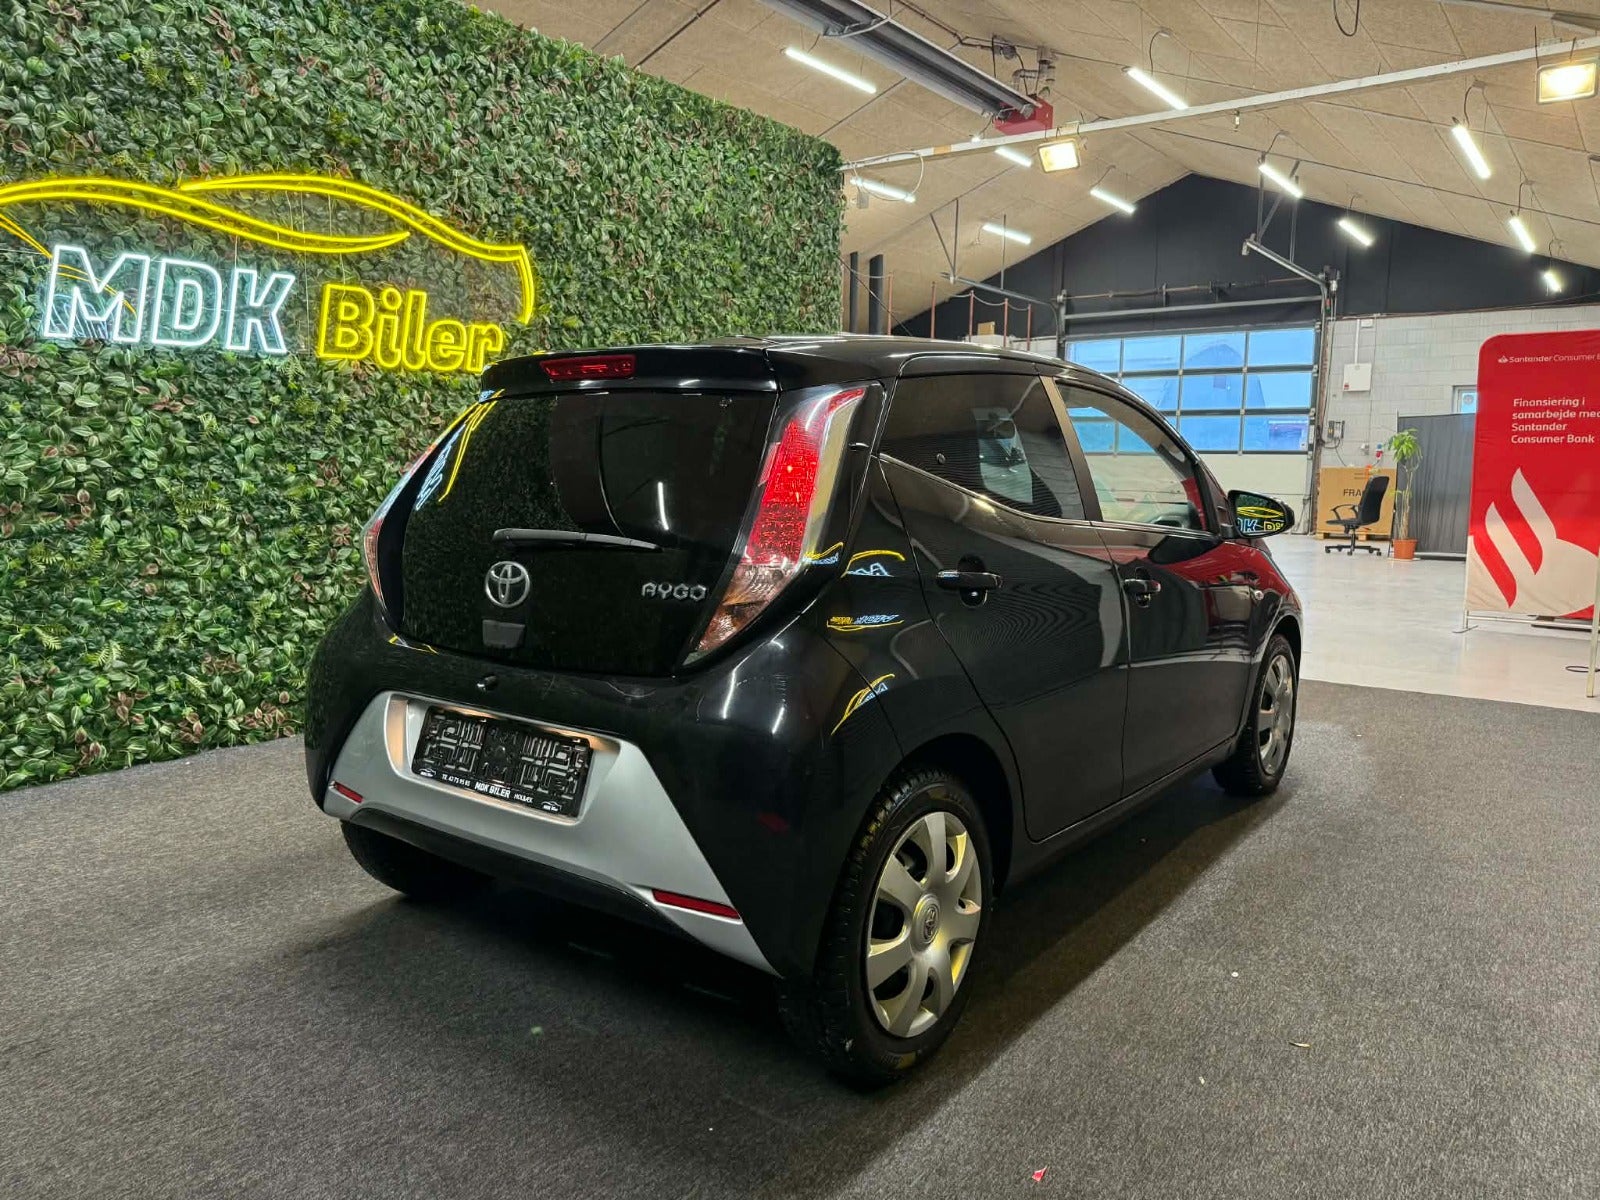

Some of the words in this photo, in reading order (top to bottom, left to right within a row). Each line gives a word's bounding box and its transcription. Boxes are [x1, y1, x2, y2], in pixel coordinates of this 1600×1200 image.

[43, 244, 295, 354] MDK
[316, 282, 504, 373] Biler
[1509, 355, 1552, 363] Santander
[1513, 397, 1580, 408] Finansiering
[1512, 409, 1576, 420] samarbejde
[1511, 422, 1568, 432] Santander
[1511, 434, 1565, 444] Consumer
[1567, 434, 1595, 443] Bank
[641, 582, 707, 601] AYGO
[474, 781, 490, 792] MDK
[489, 784, 511, 798] BILER
